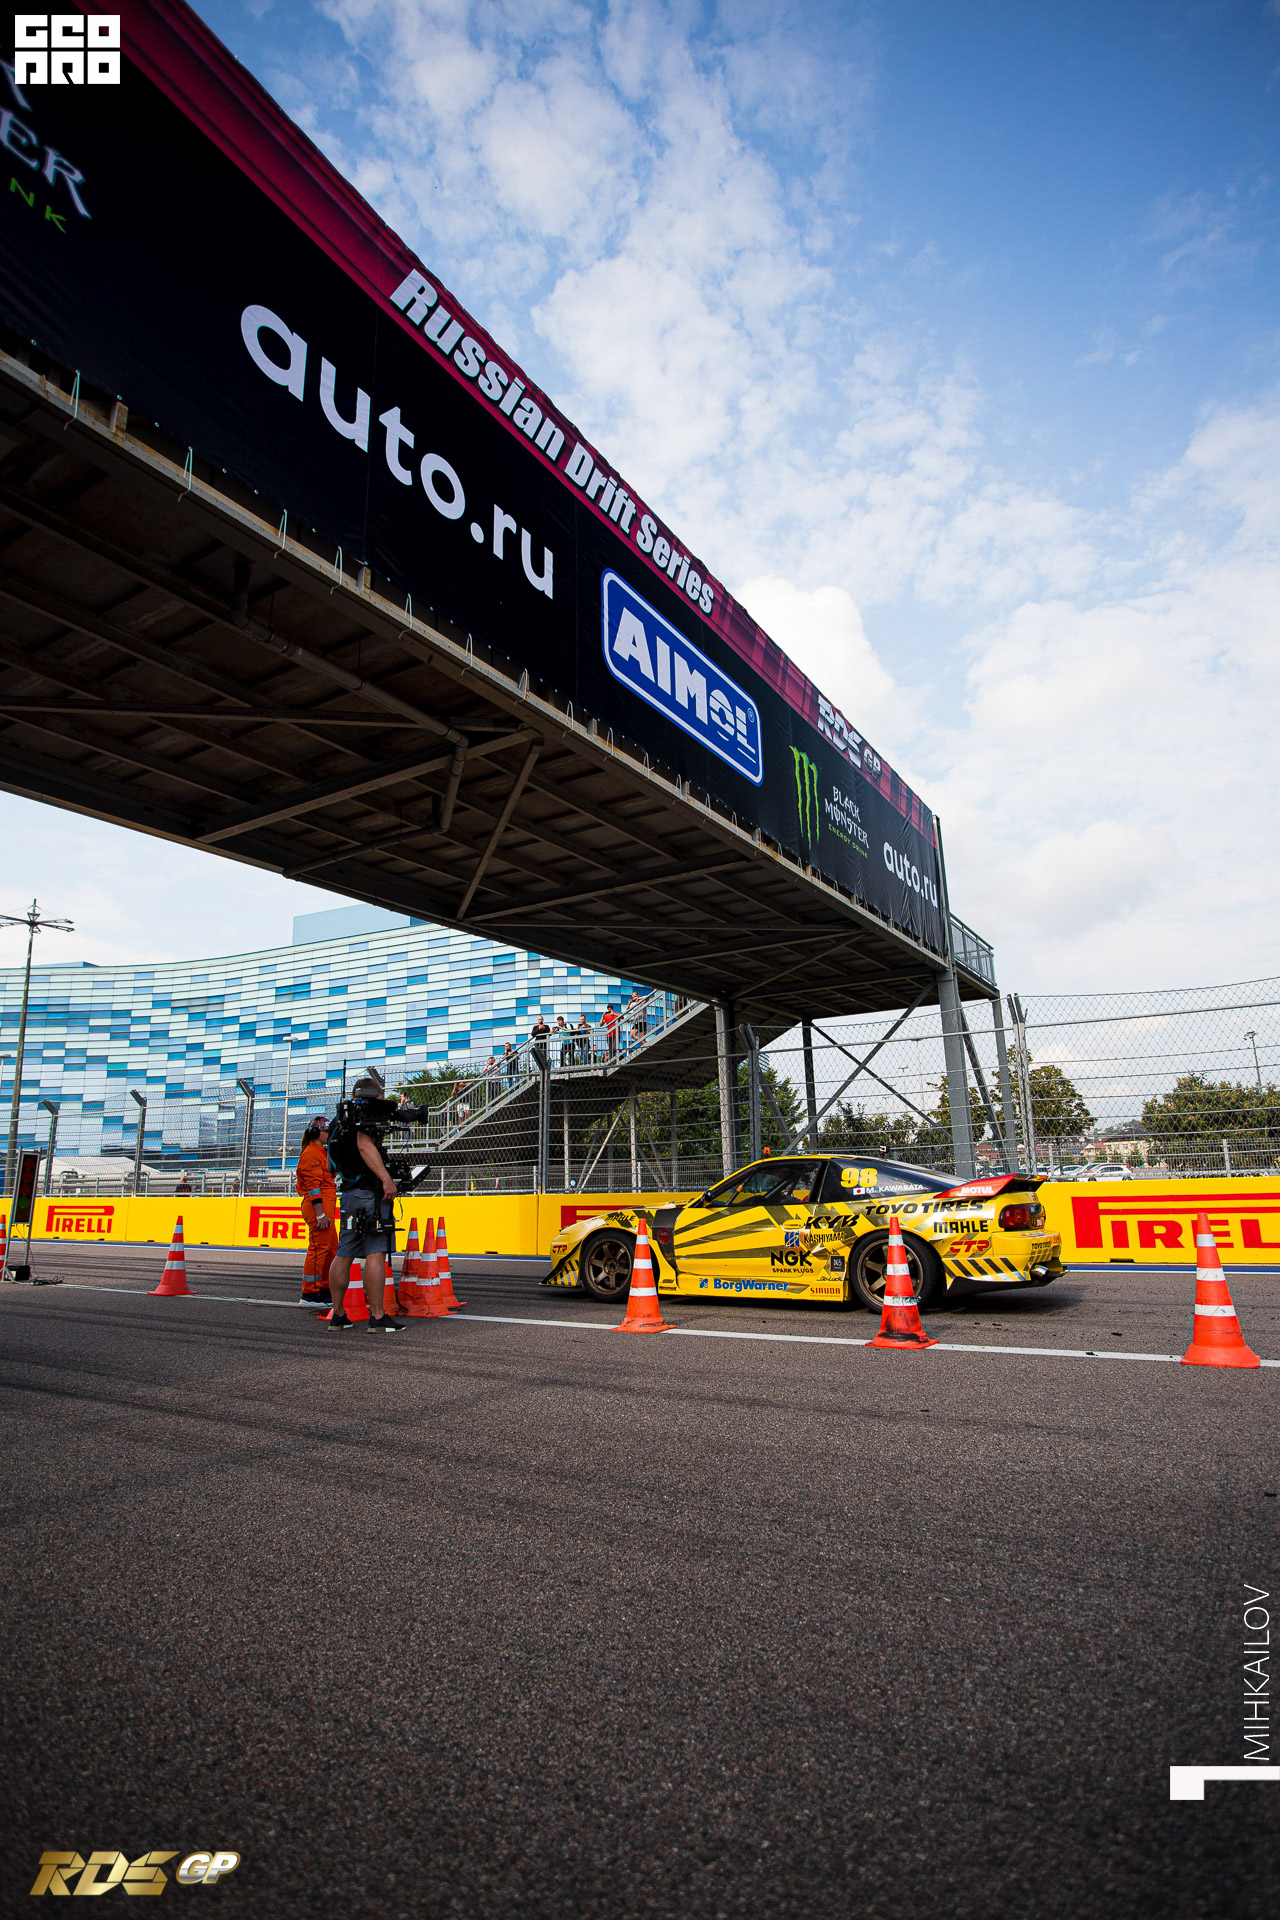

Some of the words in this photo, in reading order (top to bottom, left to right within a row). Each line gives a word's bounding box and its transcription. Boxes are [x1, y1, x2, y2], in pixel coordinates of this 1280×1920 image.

[390, 268, 565, 461] Russian
[564, 441, 636, 534] Drift
[636, 513, 714, 614] Series
[241, 304, 554, 600] auto.ru
[817, 694, 863, 769] RDS
[863, 746, 882, 779] GP
[832, 785, 861, 823] BLACK
[824, 798, 870, 849] MONSTER
[828, 823, 851, 845] ENERGY
[883, 841, 939, 909] auto.ru
[840, 1167, 878, 1188] 98
[866, 1186, 877, 1194] M.
[878, 1184, 924, 1193] KAWABATA
[960, 1186, 994, 1194] MOTUL
[604, 1214, 636, 1222] MAHLE
[865, 1202, 917, 1216] TOYO
[921, 1200, 984, 1214] TIRES
[46, 1205, 115, 1233] PIRELLI
[248, 1206, 341, 1240] PIRE
[804, 1215, 860, 1230] KYB
[934, 1220, 988, 1234] MAHLE
[1071, 1192, 1280, 1249] PIREL
[803, 1231, 845, 1244] KASHIYAMA
[771, 1250, 812, 1266] NGK
[713, 1278, 789, 1292] BorgWarner
